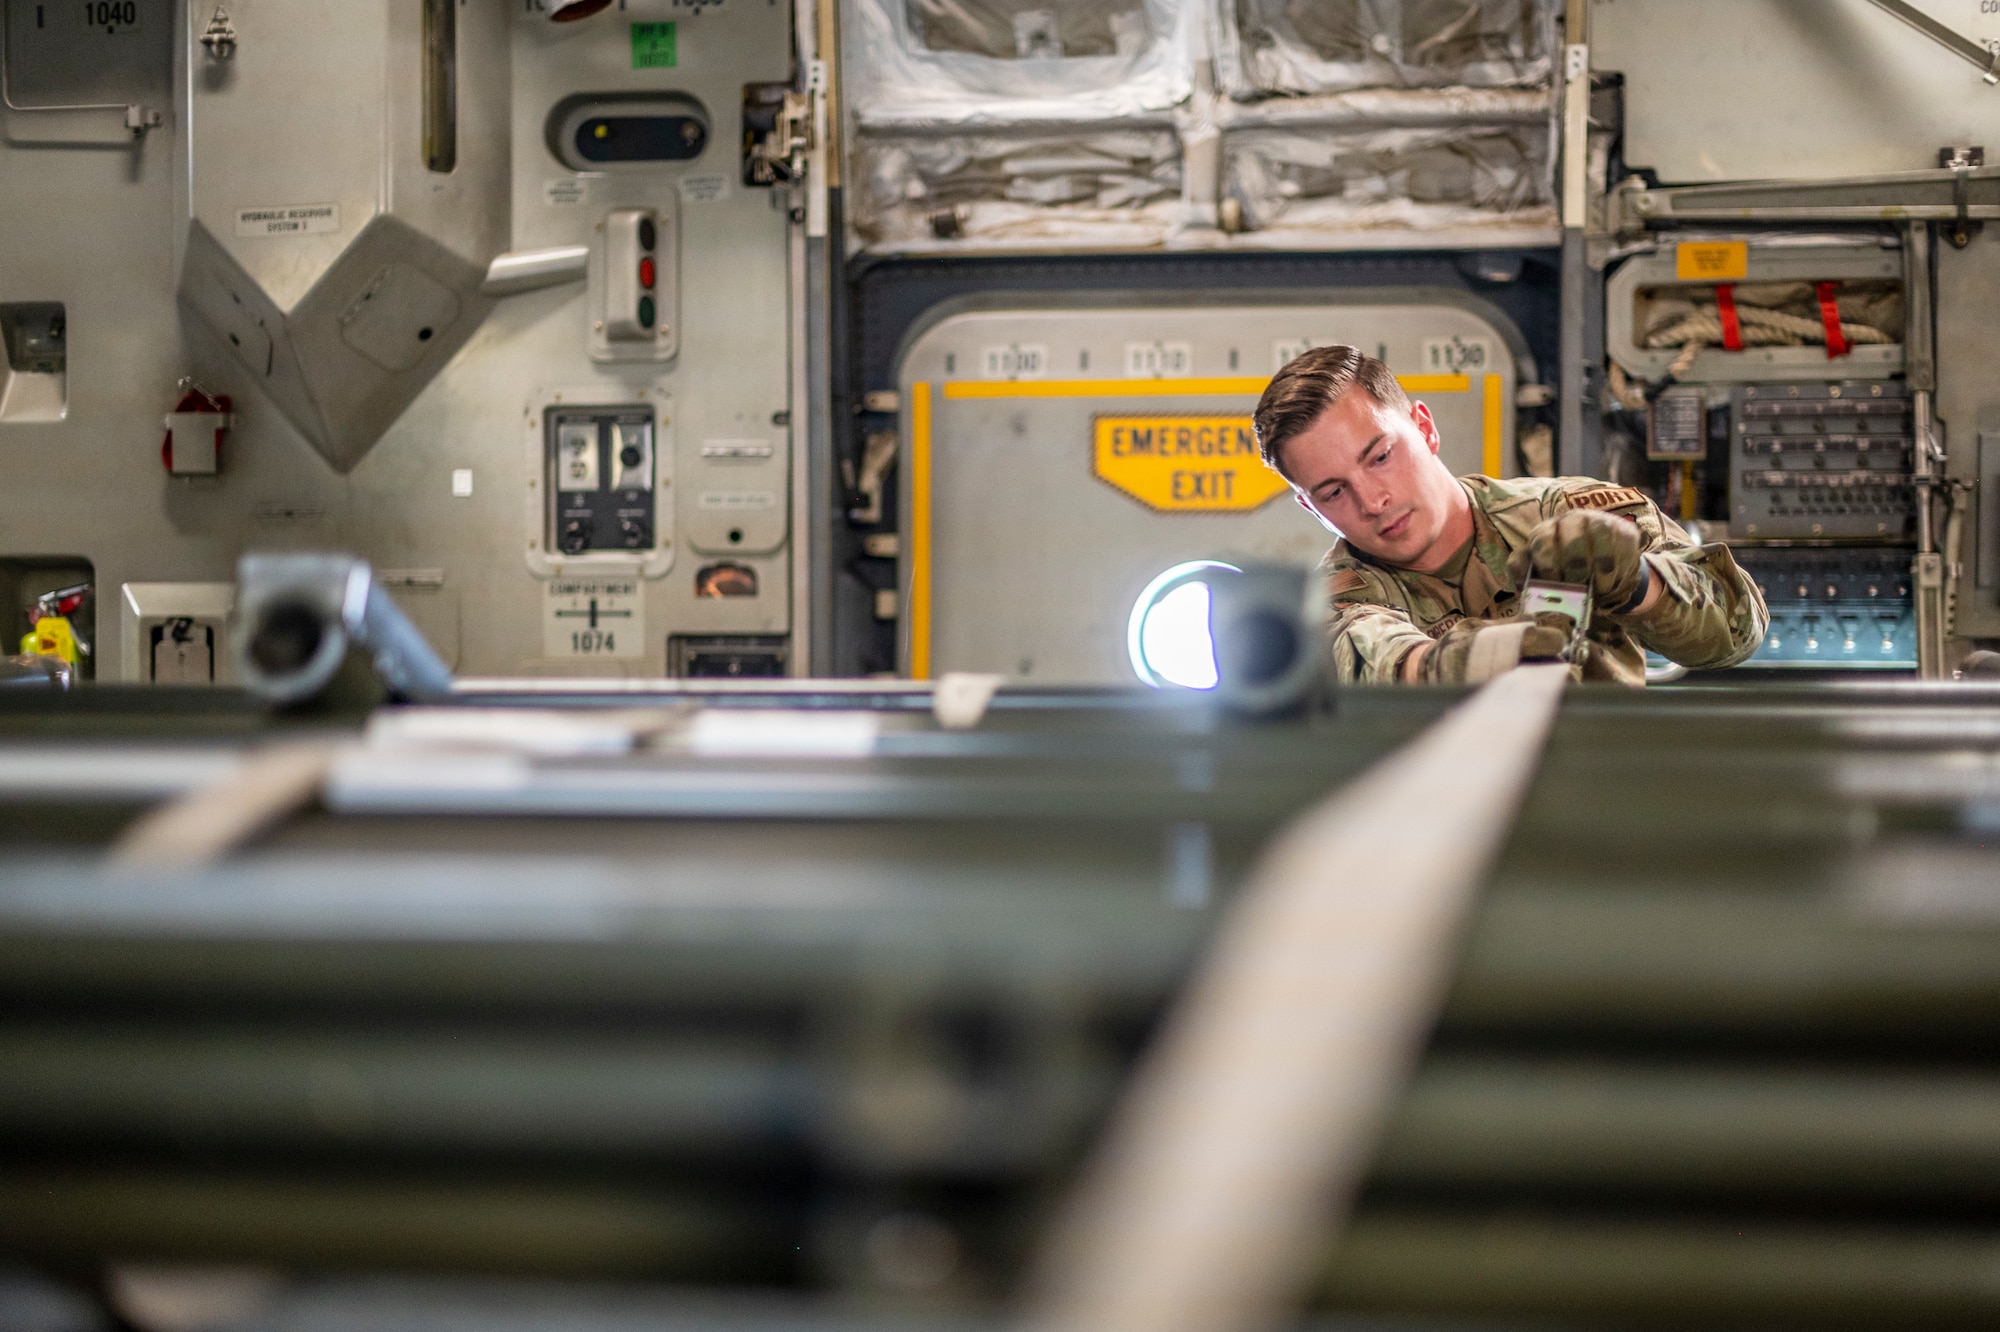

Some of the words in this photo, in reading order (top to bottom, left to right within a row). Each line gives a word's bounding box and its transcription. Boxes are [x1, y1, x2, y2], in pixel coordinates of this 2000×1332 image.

[86, 0, 136, 25] 1040
[1980, 0, 2000, 13] CO
[1112, 426, 1254, 457] EMERGEN
[1172, 470, 1236, 500] EXIT
[1573, 491, 1635, 508] PORT
[550, 583, 637, 595] COMPARTMENT
[572, 632, 615, 653] 1074
